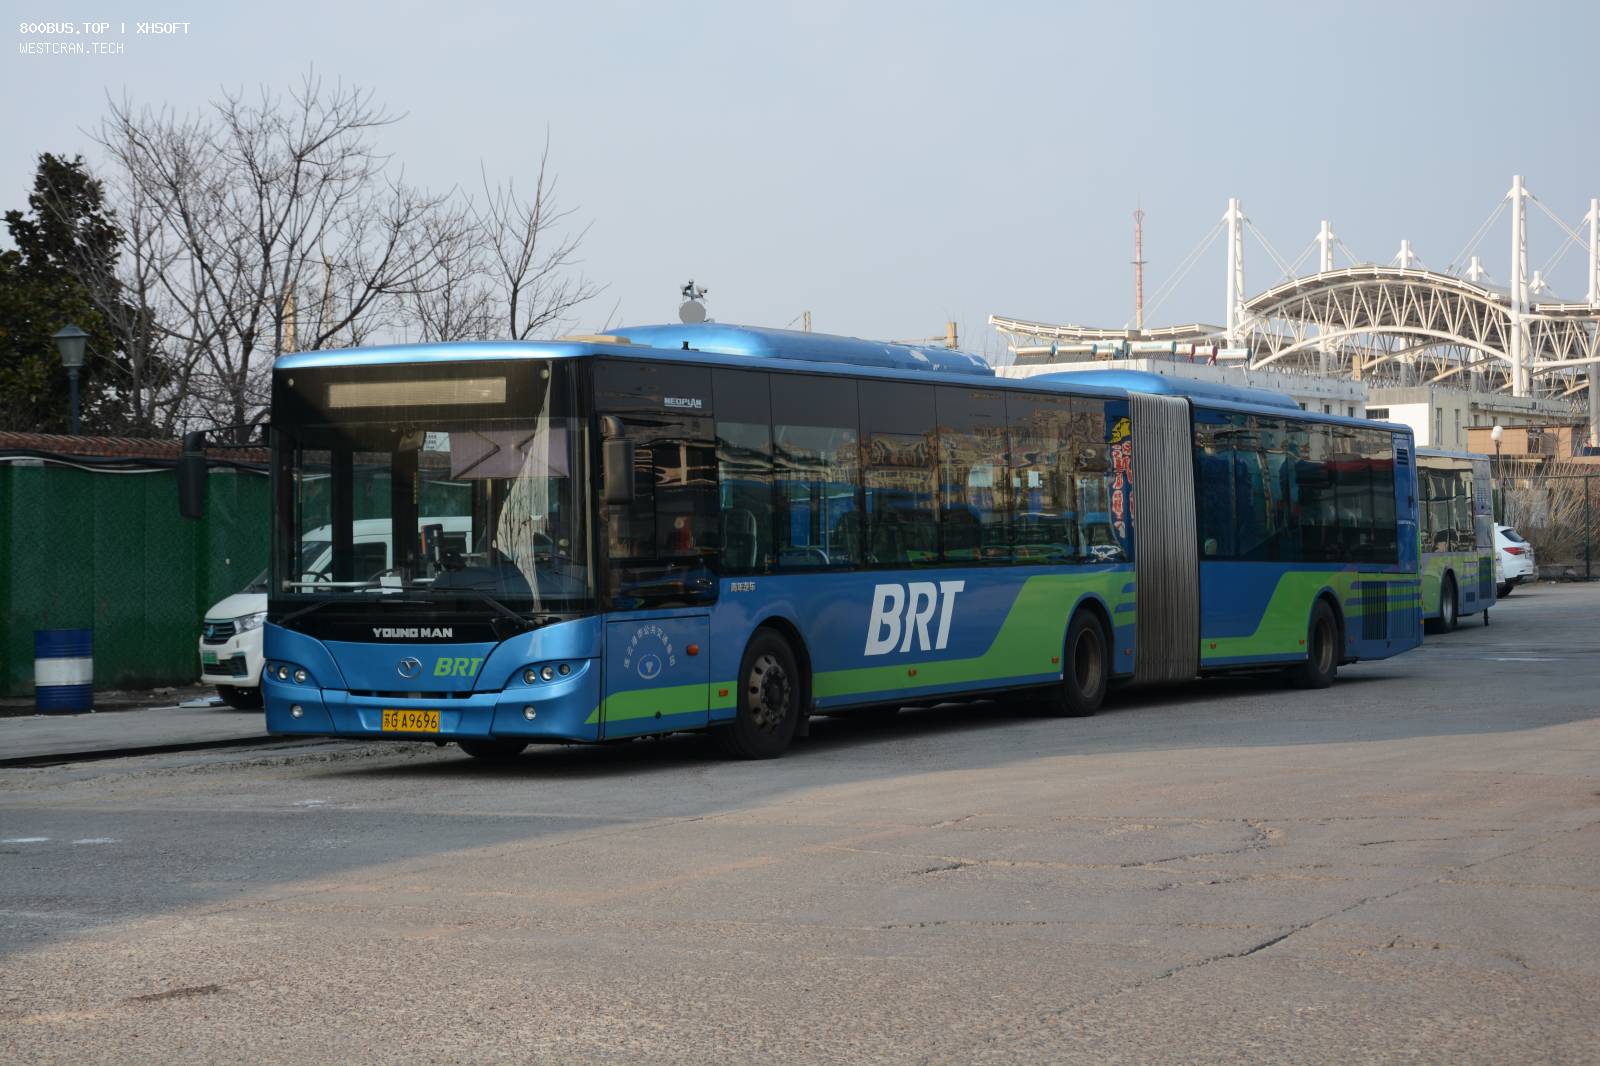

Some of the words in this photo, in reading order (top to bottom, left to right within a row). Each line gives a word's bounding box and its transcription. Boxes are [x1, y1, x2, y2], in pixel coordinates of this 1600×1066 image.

[864, 580, 965, 656] BRT
[373, 628, 418, 638] YOUNG
[420, 628, 453, 638] MAN
[433, 657, 483, 677] BRT
